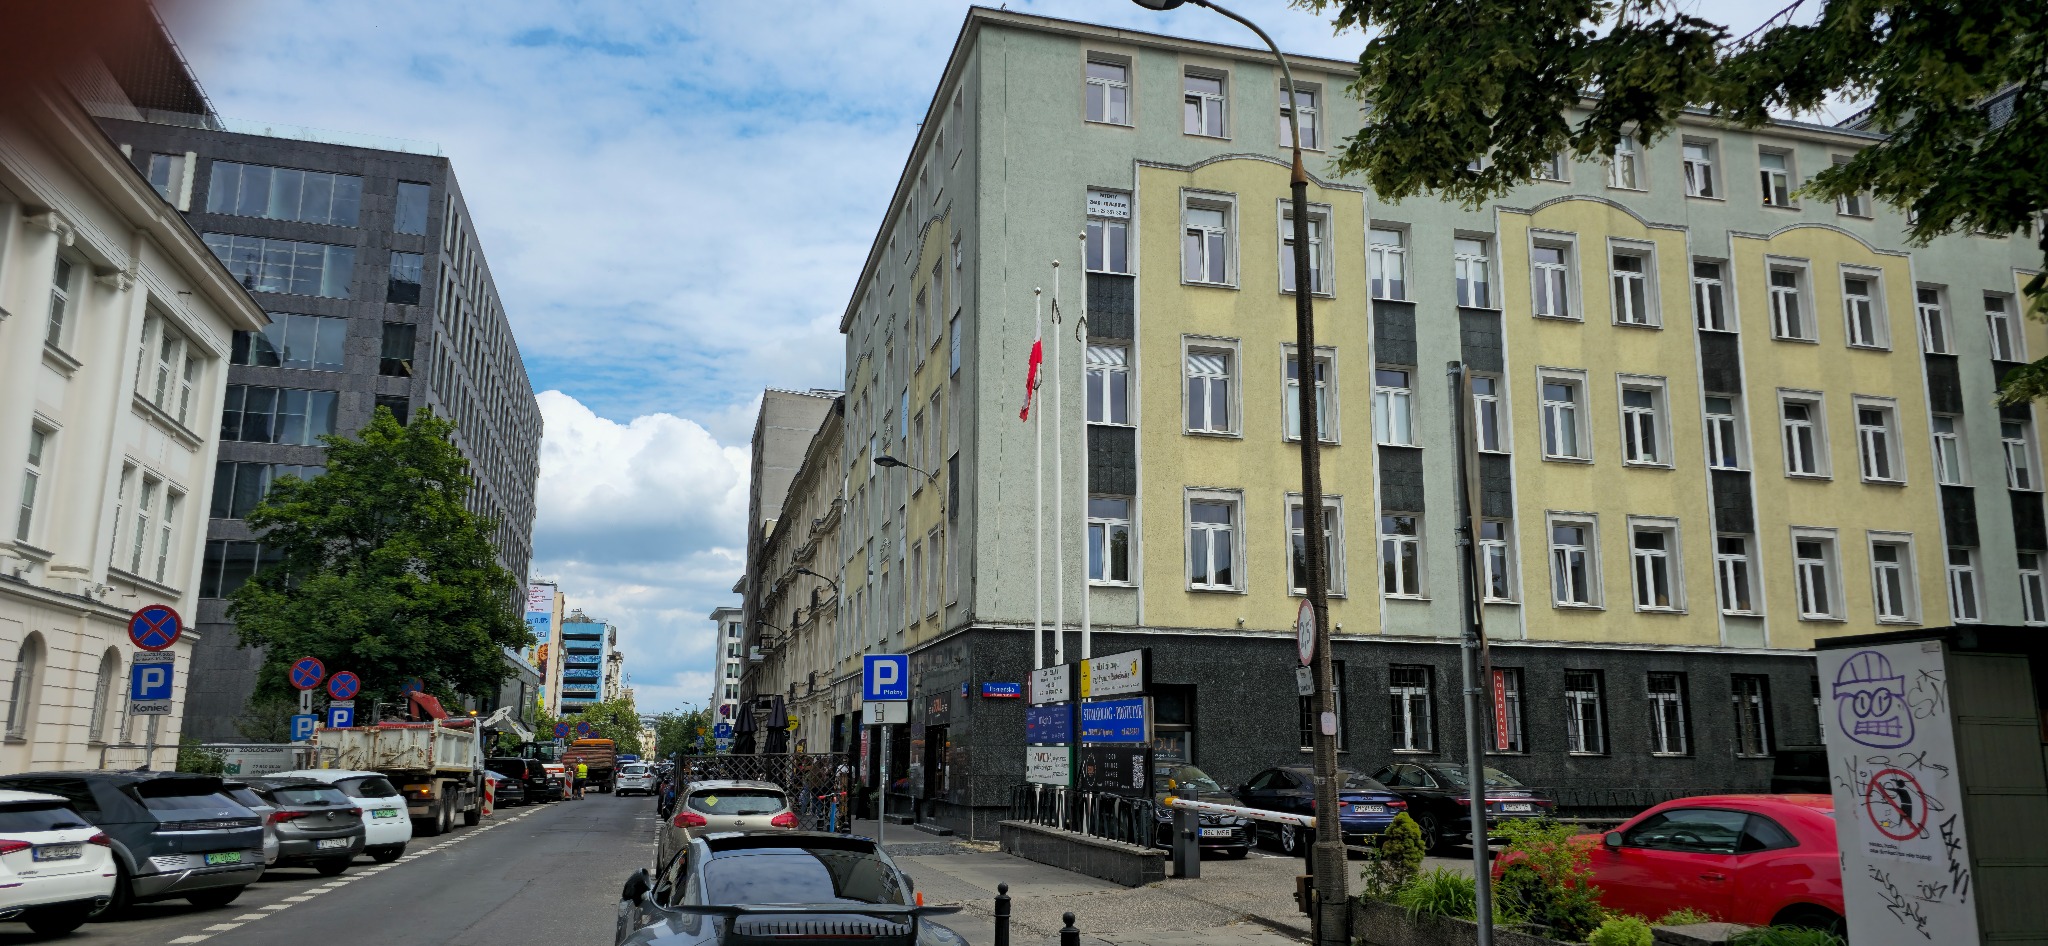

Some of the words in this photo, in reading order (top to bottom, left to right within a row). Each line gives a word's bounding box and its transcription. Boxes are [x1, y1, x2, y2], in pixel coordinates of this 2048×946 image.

[140, 668, 165, 696] P
[873, 660, 899, 695] P
[133, 703, 168, 712] Koniec
[333, 710, 348, 728] P
[1496, 675, 1505, 744] NOTARIALNA
[297, 718, 312, 737] P
